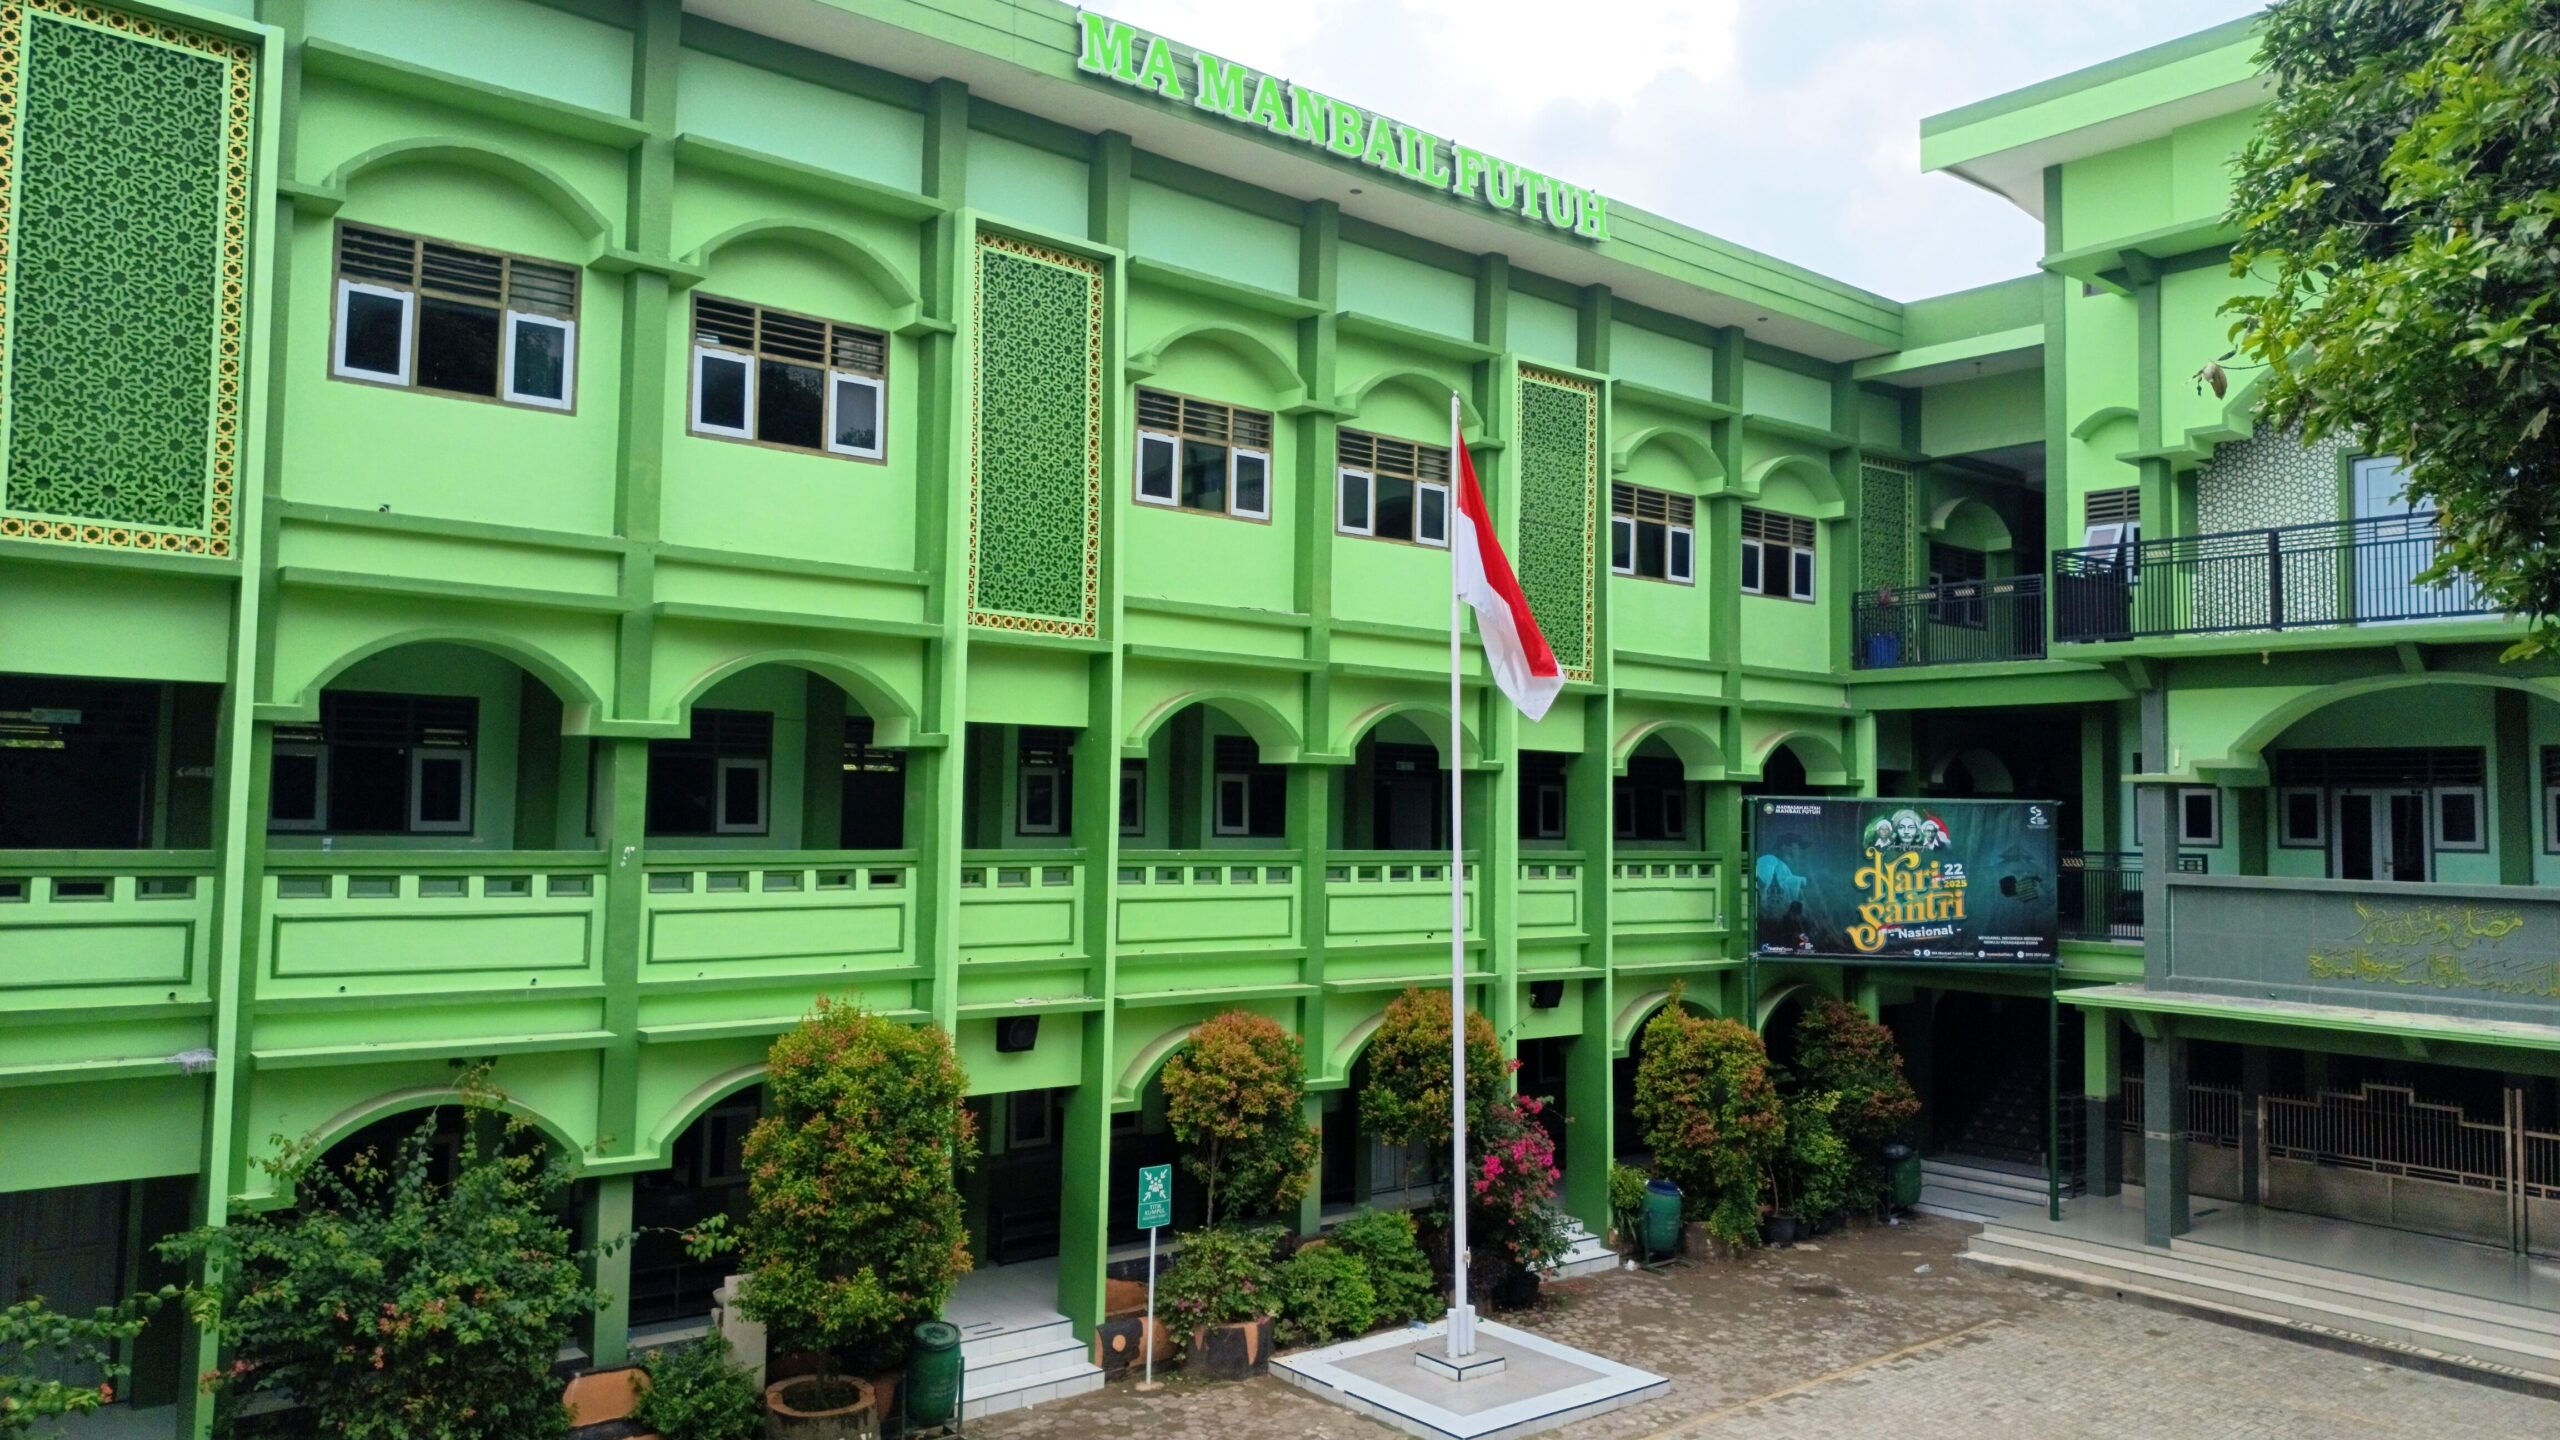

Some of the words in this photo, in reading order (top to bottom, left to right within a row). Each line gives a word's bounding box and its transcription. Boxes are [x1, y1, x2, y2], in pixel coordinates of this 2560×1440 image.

[1077, 10, 1184, 100] MA
[1193, 52, 1450, 190] MANBAIL
[1452, 142, 1611, 242] FUTUH
[1855, 847, 1940, 902] Hari
[1944, 863, 1964, 876] 22
[1944, 880, 1968, 888] 2025
[1846, 889, 1966, 952] Santri
[1898, 925, 1954, 939] Nasional
